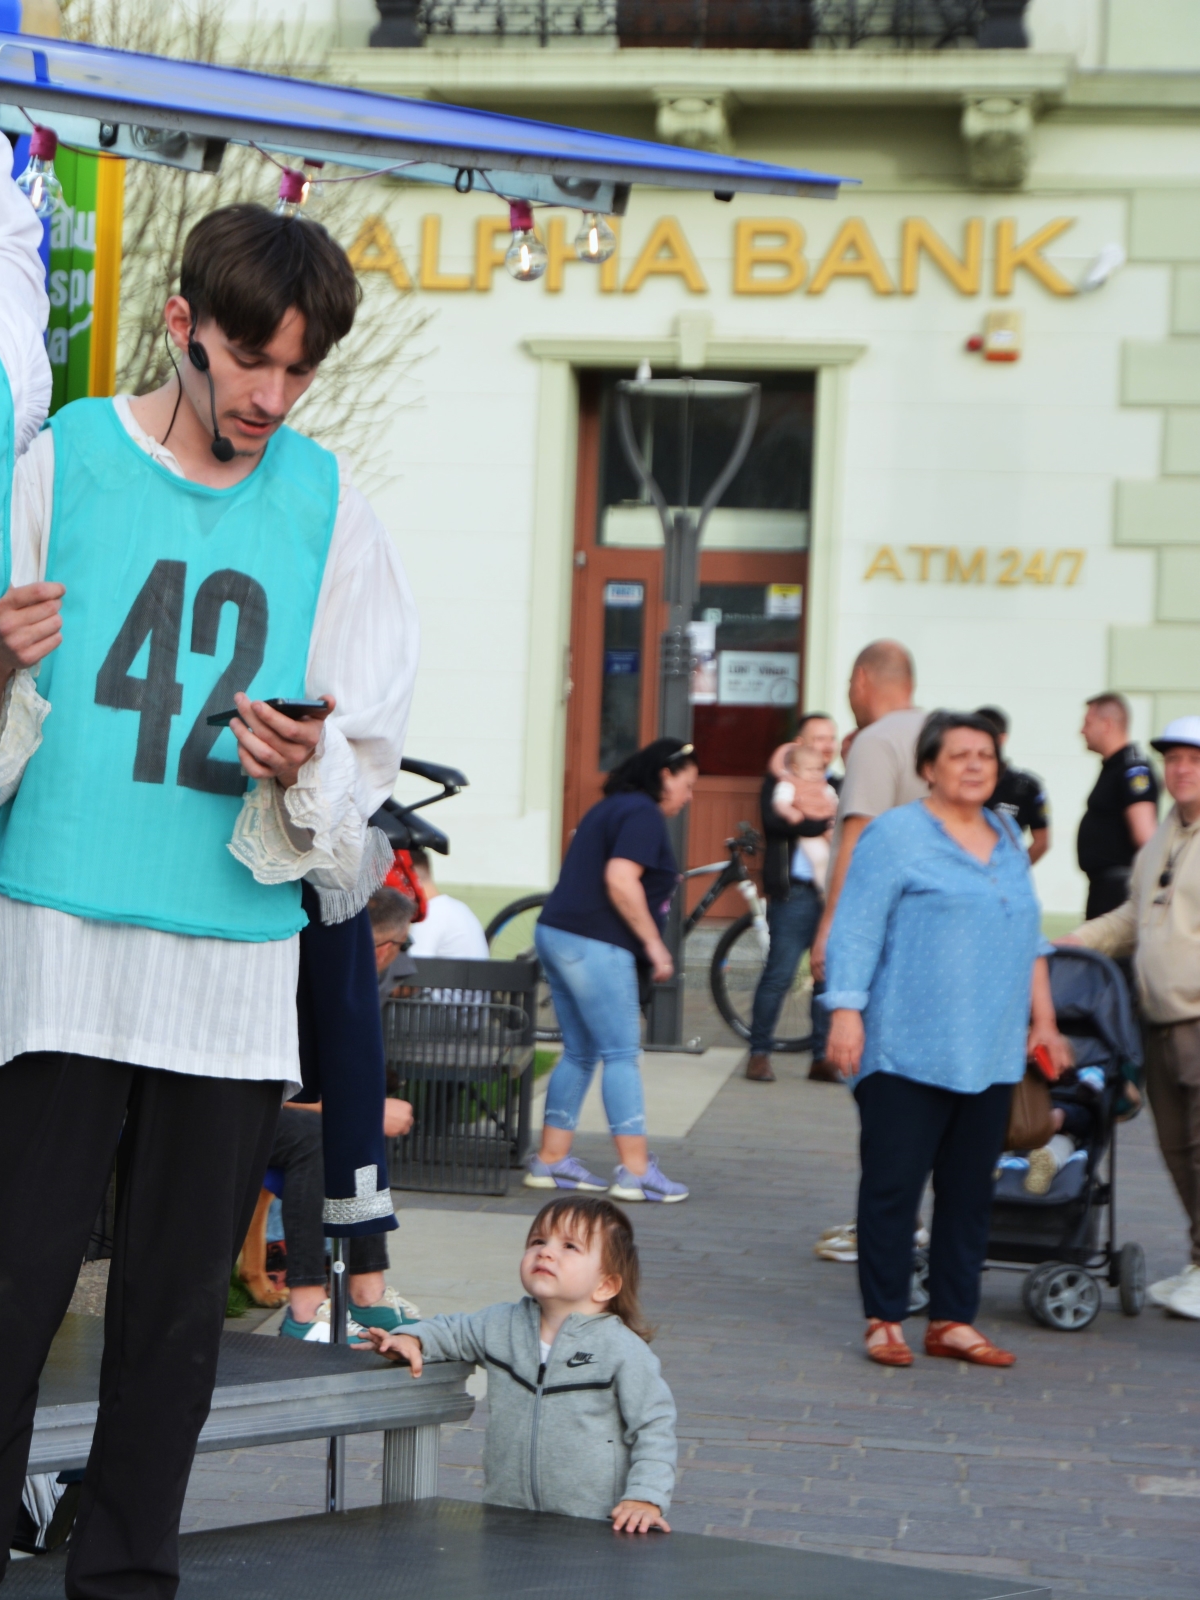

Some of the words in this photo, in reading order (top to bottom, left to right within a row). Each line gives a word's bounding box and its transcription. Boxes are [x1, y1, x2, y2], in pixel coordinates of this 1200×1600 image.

[343, 214, 709, 293] ALPHA
[731, 216, 1080, 296] BANK
[862, 544, 988, 585] ATM
[996, 546, 1088, 588] 24/7
[95, 559, 269, 796] 42
[573, 1351, 595, 1363] NIKE
